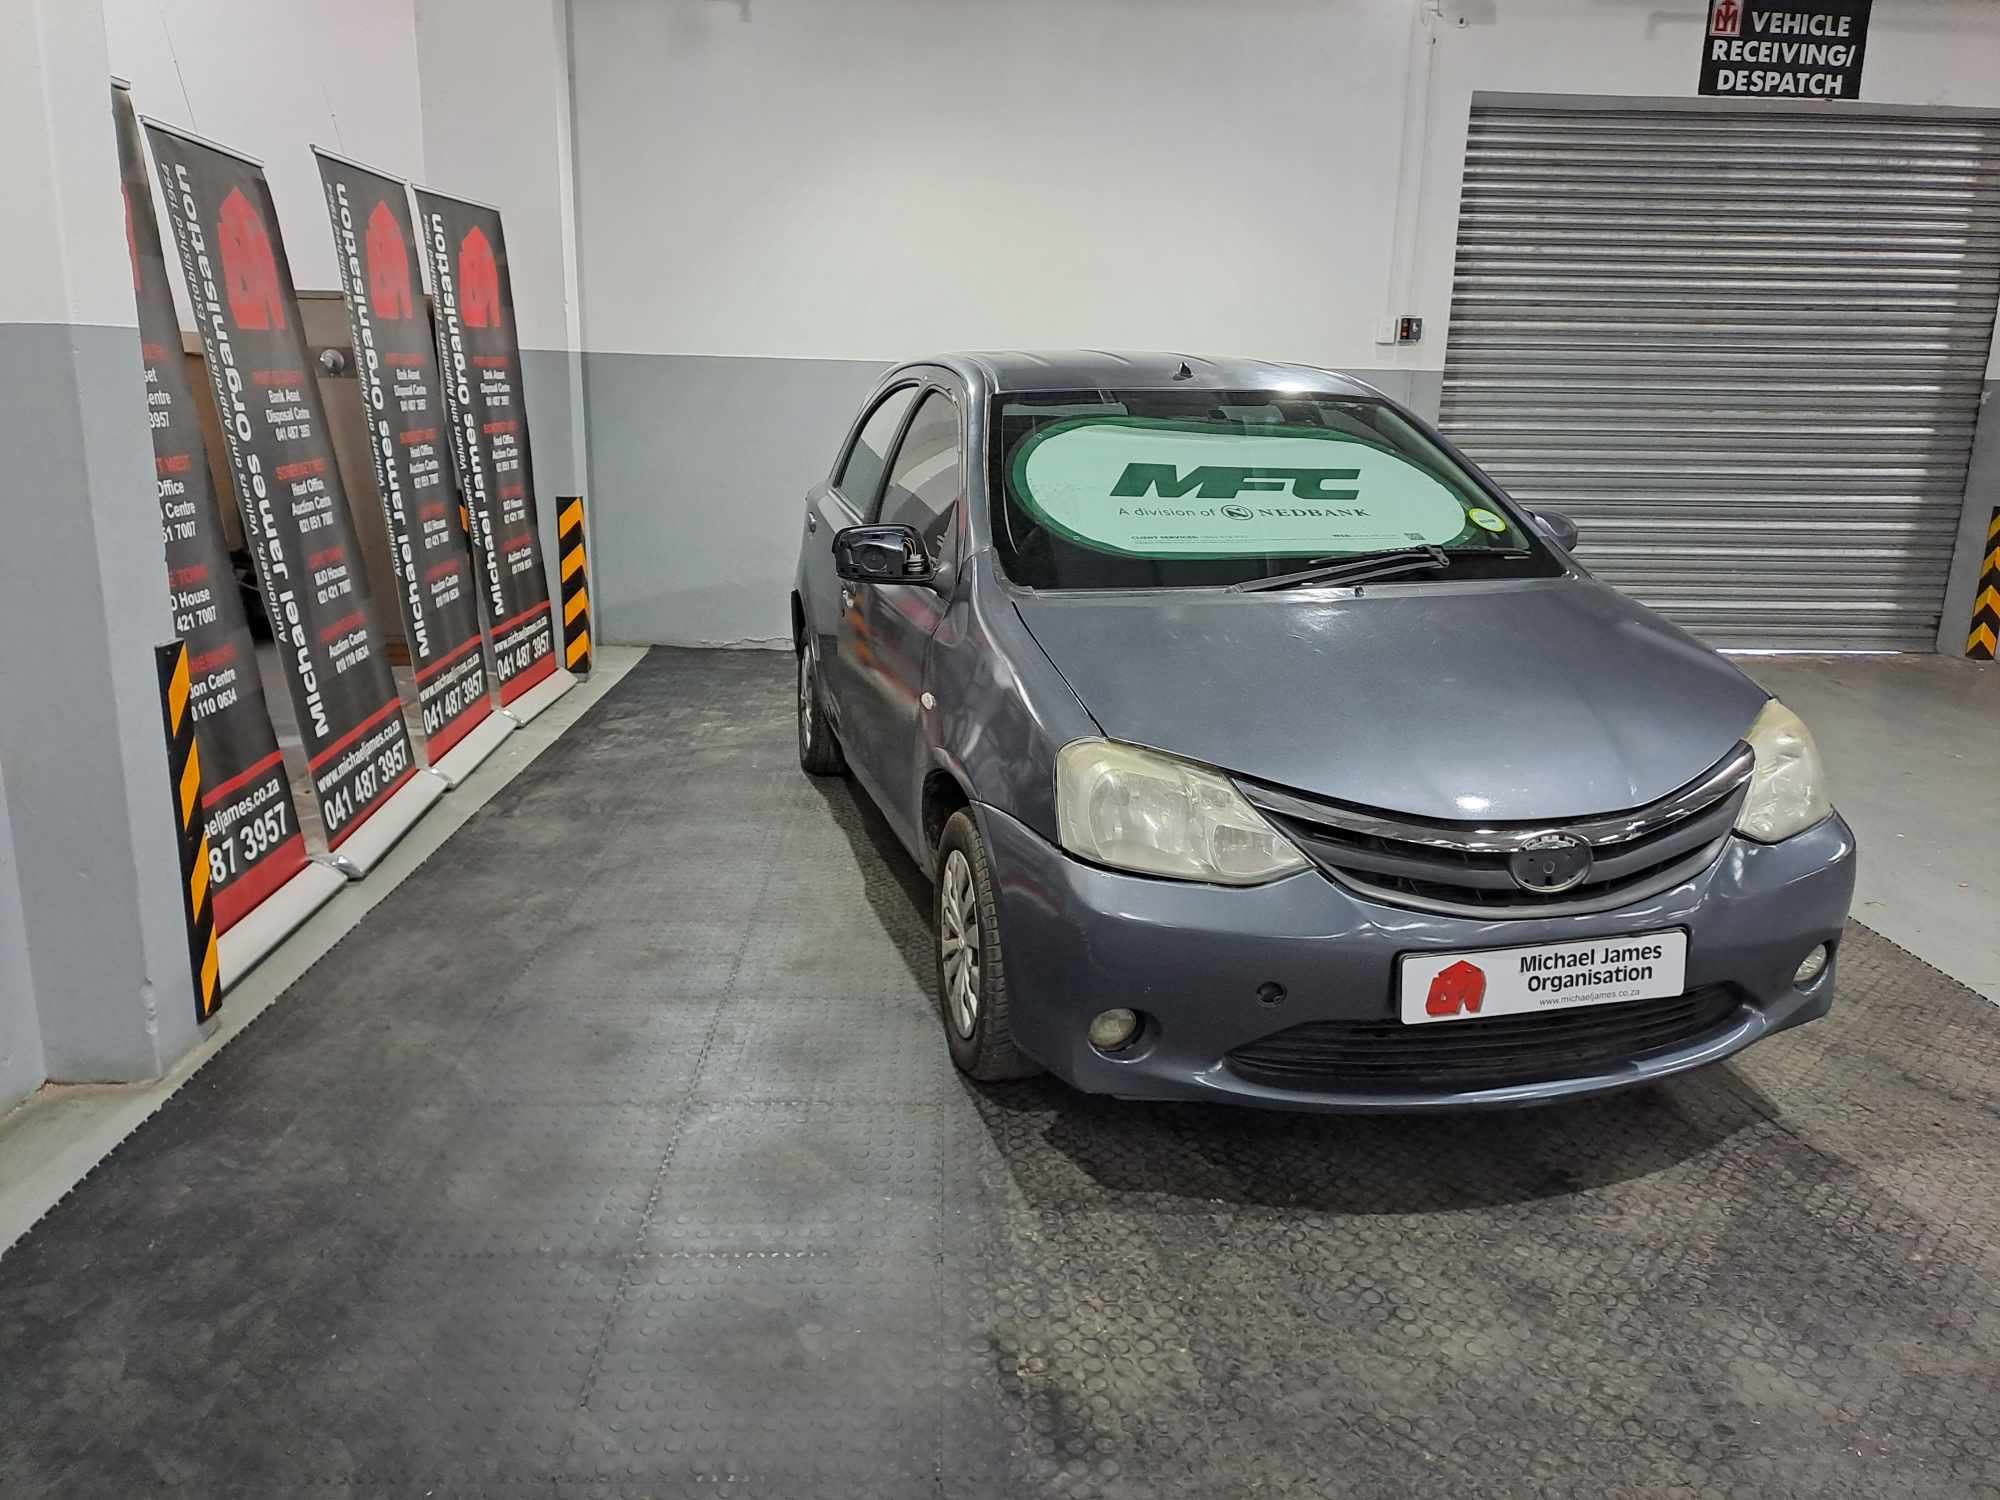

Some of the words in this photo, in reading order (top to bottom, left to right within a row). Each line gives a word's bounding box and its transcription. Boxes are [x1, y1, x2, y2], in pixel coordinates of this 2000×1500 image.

[1752, 11, 1851, 37] VEHICLE
[1712, 39, 1856, 67] RECEIVING/
[1717, 69, 1843, 96] DESPATCH
[161, 162, 179, 208] 1964
[173, 214, 206, 321] Established
[174, 163, 252, 442] Organisation
[336, 182, 384, 411] Organisation
[431, 212, 470, 405] Organisation
[147, 388, 172, 406] entre
[204, 337, 234, 431] Appraisers
[448, 398, 460, 423] and
[227, 434, 243, 468] and
[378, 420, 406, 526] James
[463, 413, 486, 503] James
[238, 472, 260, 536] Valuers
[1109, 462, 1361, 500] MFC
[165, 501, 196, 519] Centre
[177, 521, 197, 540] 7007
[247, 454, 289, 580] James
[1118, 507, 1130, 517] A
[1134, 505, 1196, 517] division
[1200, 507, 1216, 517] of
[1258, 507, 1372, 518] NEDBANK
[478, 510, 504, 616] Michael
[178, 588, 211, 609] House
[256, 541, 288, 643] Auctioneers,
[397, 534, 430, 659] Michael
[177, 614, 196, 632] 421
[195, 605, 217, 626] 7007
[279, 590, 330, 738] Michael
[497, 652, 516, 681] 041
[515, 642, 531, 668] 487
[532, 630, 549, 659] 3957
[208, 668, 237, 690] Centre
[423, 700, 444, 735] 041
[445, 686, 462, 717] 487
[461, 669, 483, 704] 3957
[198, 698, 217, 717] 110
[324, 785, 354, 831] 041
[354, 763, 378, 803] 487
[377, 738, 408, 783] 3957
[207, 837, 236, 888] 87
[240, 801, 288, 861] 3957
[1520, 948, 1595, 974] Michael
[1600, 944, 1662, 965] James
[1527, 964, 1653, 993] Organisation
[1538, 987, 1640, 1006] www.michaeljames.co.za
